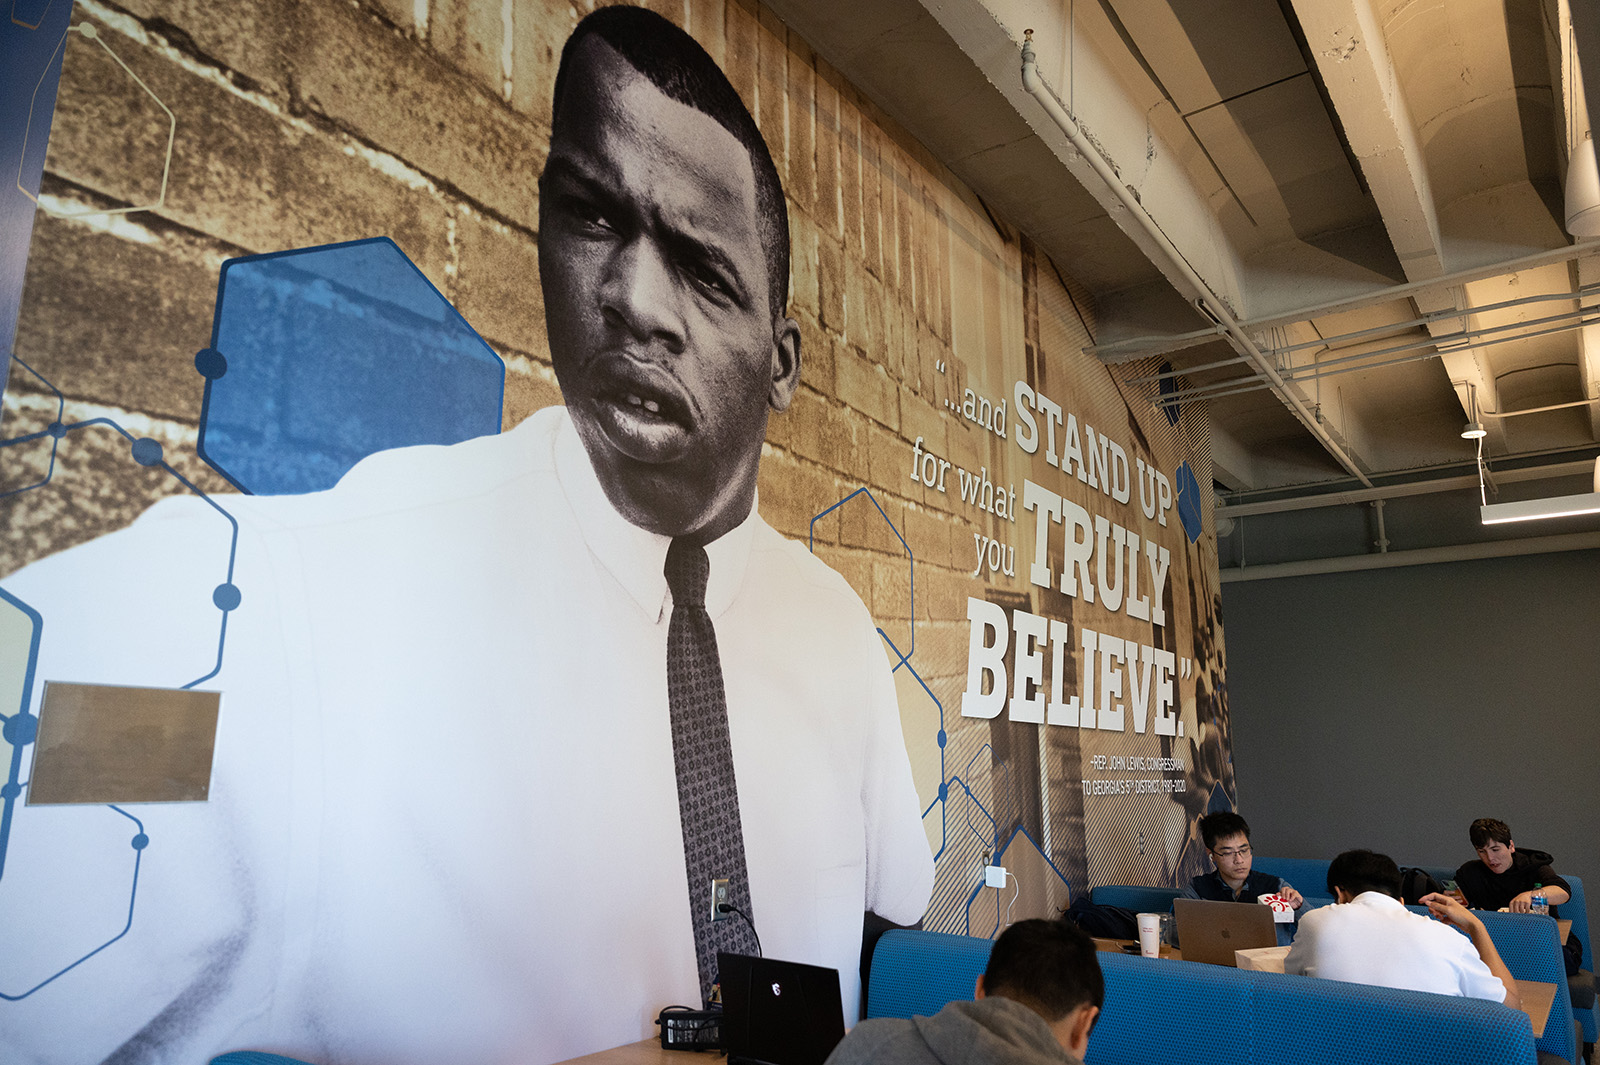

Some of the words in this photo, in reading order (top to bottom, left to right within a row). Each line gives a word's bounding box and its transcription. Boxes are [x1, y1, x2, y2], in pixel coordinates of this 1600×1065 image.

[910, 436, 951, 492] for
[958, 464, 1016, 522] what
[1014, 380, 1131, 504] STAND
[1136, 457, 1172, 526] UP
[973, 532, 1015, 577] you
[1023, 479, 1170, 627] TRULY
[1081, 780, 1091, 795] TO
[1109, 755, 1126, 770] JOHN
[1126, 756, 1146, 772] LEWIS,
[1147, 757, 1185, 771] CONGRESSMAN
